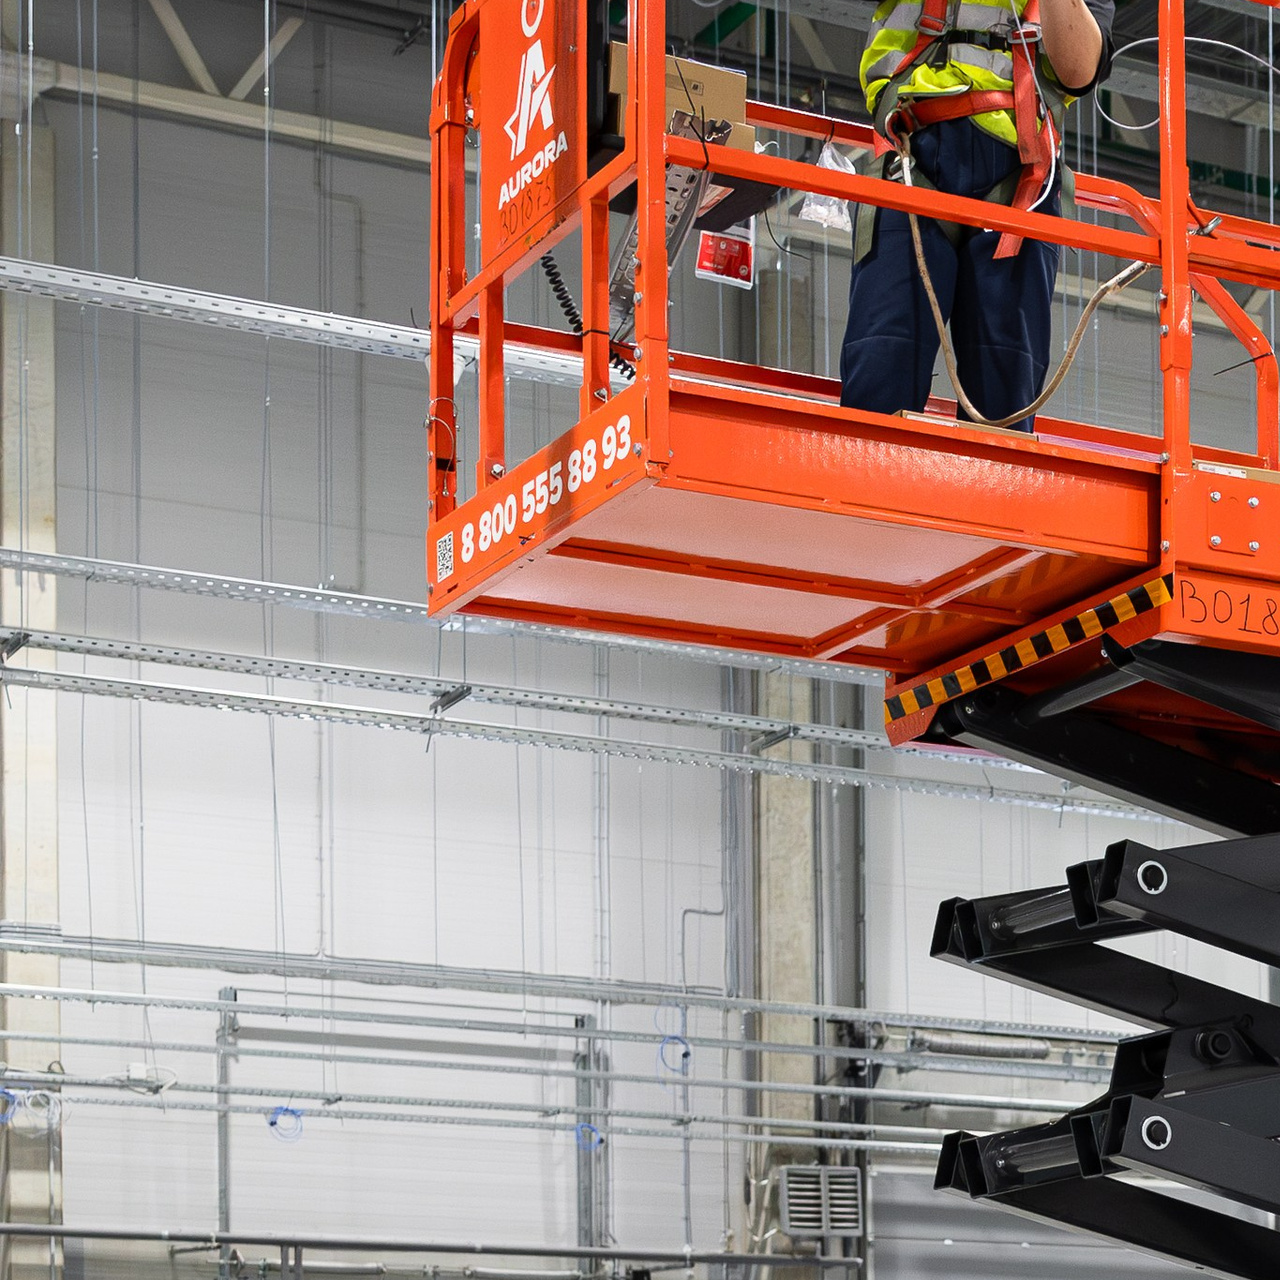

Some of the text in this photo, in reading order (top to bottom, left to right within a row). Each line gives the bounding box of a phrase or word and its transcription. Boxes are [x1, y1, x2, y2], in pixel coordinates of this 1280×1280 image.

[498, 130, 568, 211] AURORA
[461, 414, 631, 563] 8 800 555 88 93
